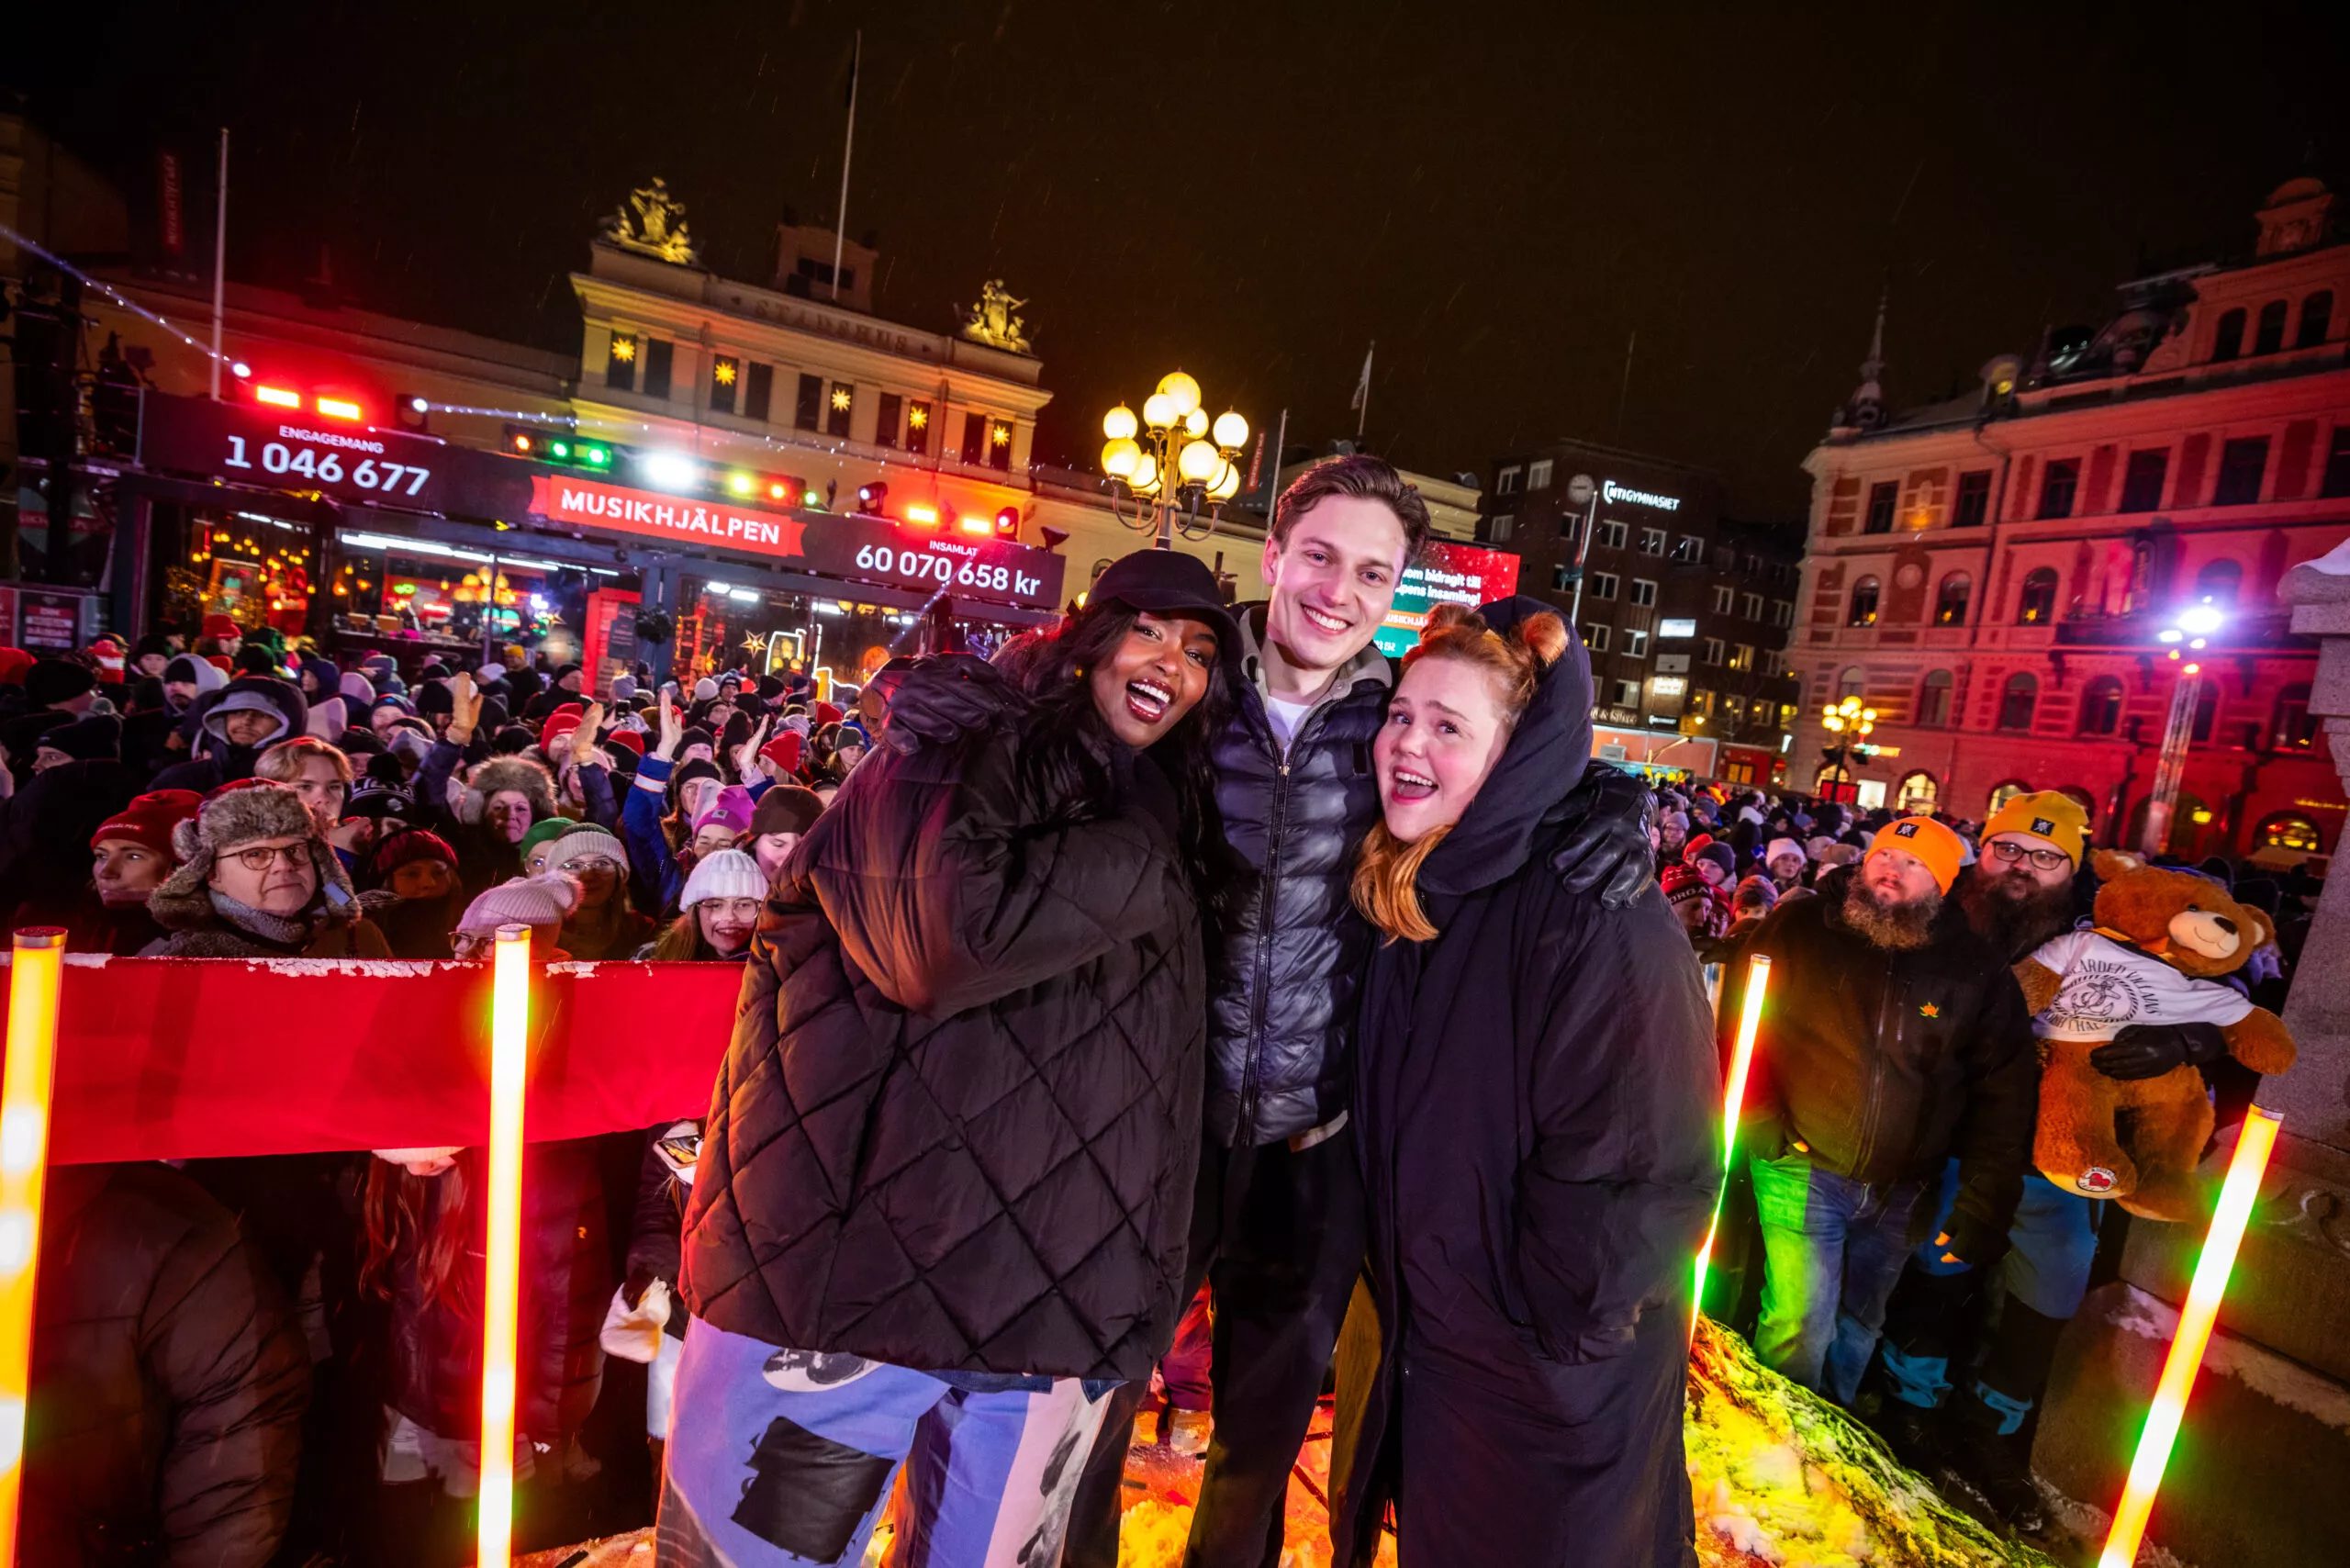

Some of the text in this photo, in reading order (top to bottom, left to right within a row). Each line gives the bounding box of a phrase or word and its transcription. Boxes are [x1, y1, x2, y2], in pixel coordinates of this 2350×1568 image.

[755, 299, 909, 353] STADSHUS
[279, 425, 385, 454] ENGAGEMANG
[225, 435, 431, 496] 1 046 677
[561, 487, 780, 544] MUSIKHJÄLPEN
[929, 540, 978, 556] INSAMLAT
[856, 544, 1041, 596] 60 070 658 kr
[1425, 568, 1466, 588] bidragit
[1466, 575, 1482, 589] till
[1427, 586, 1482, 607] insamling!
